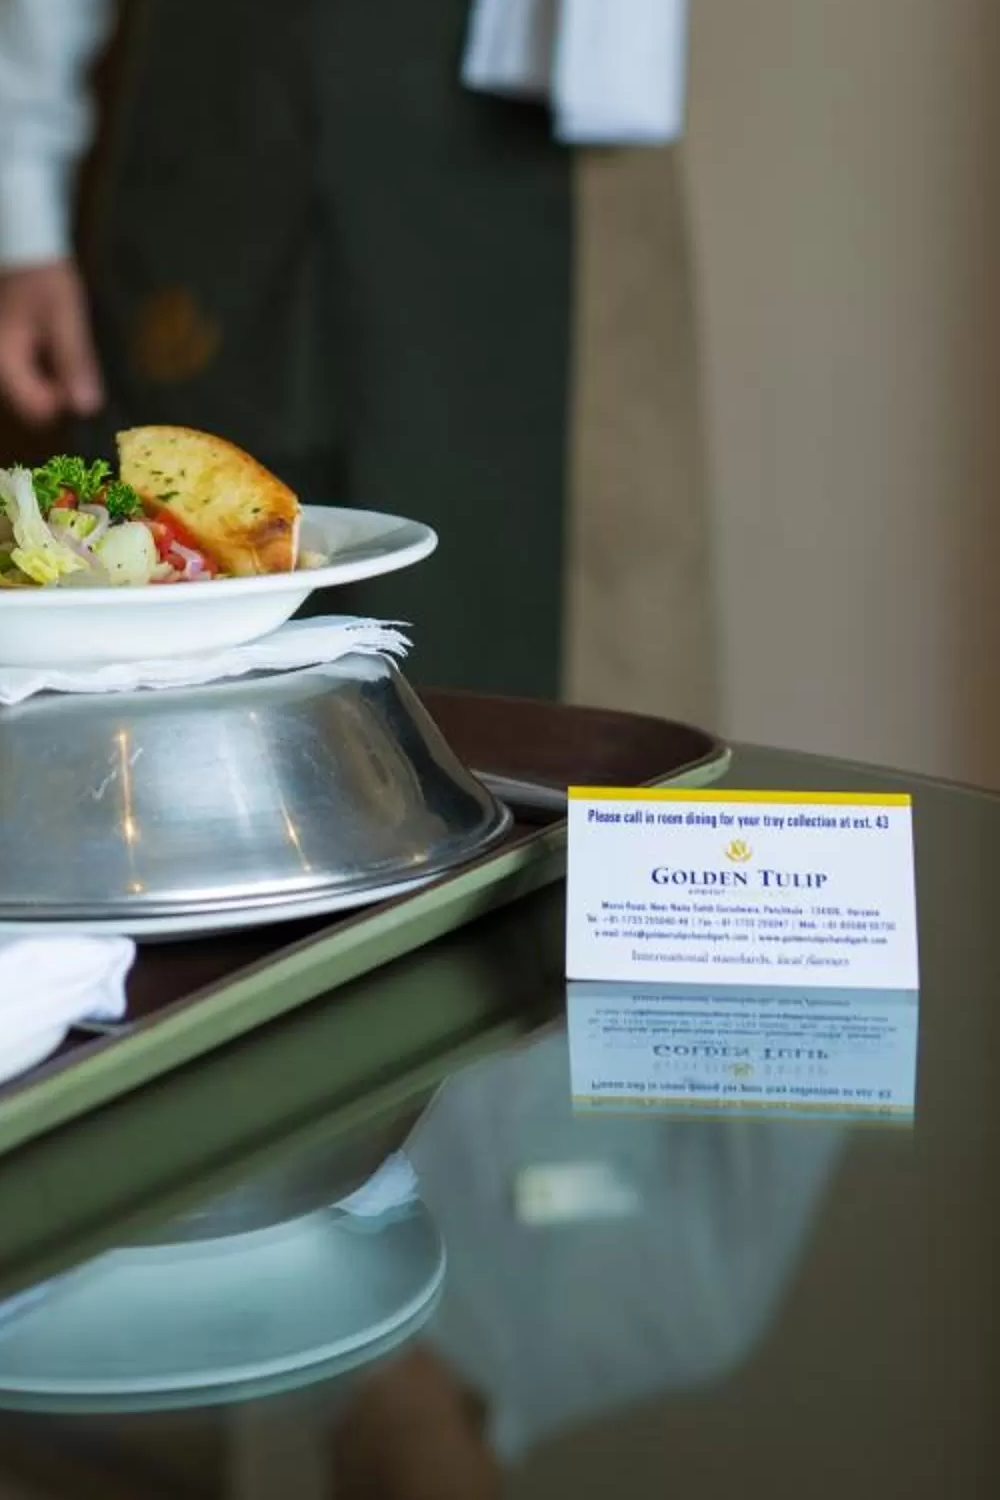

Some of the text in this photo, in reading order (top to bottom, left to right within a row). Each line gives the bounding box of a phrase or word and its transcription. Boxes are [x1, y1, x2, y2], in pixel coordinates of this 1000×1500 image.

[587, 809, 889, 830] Please call in room dining for your tray collection at ext. 43
[650, 866, 828, 889] GOLDEN TULIP
